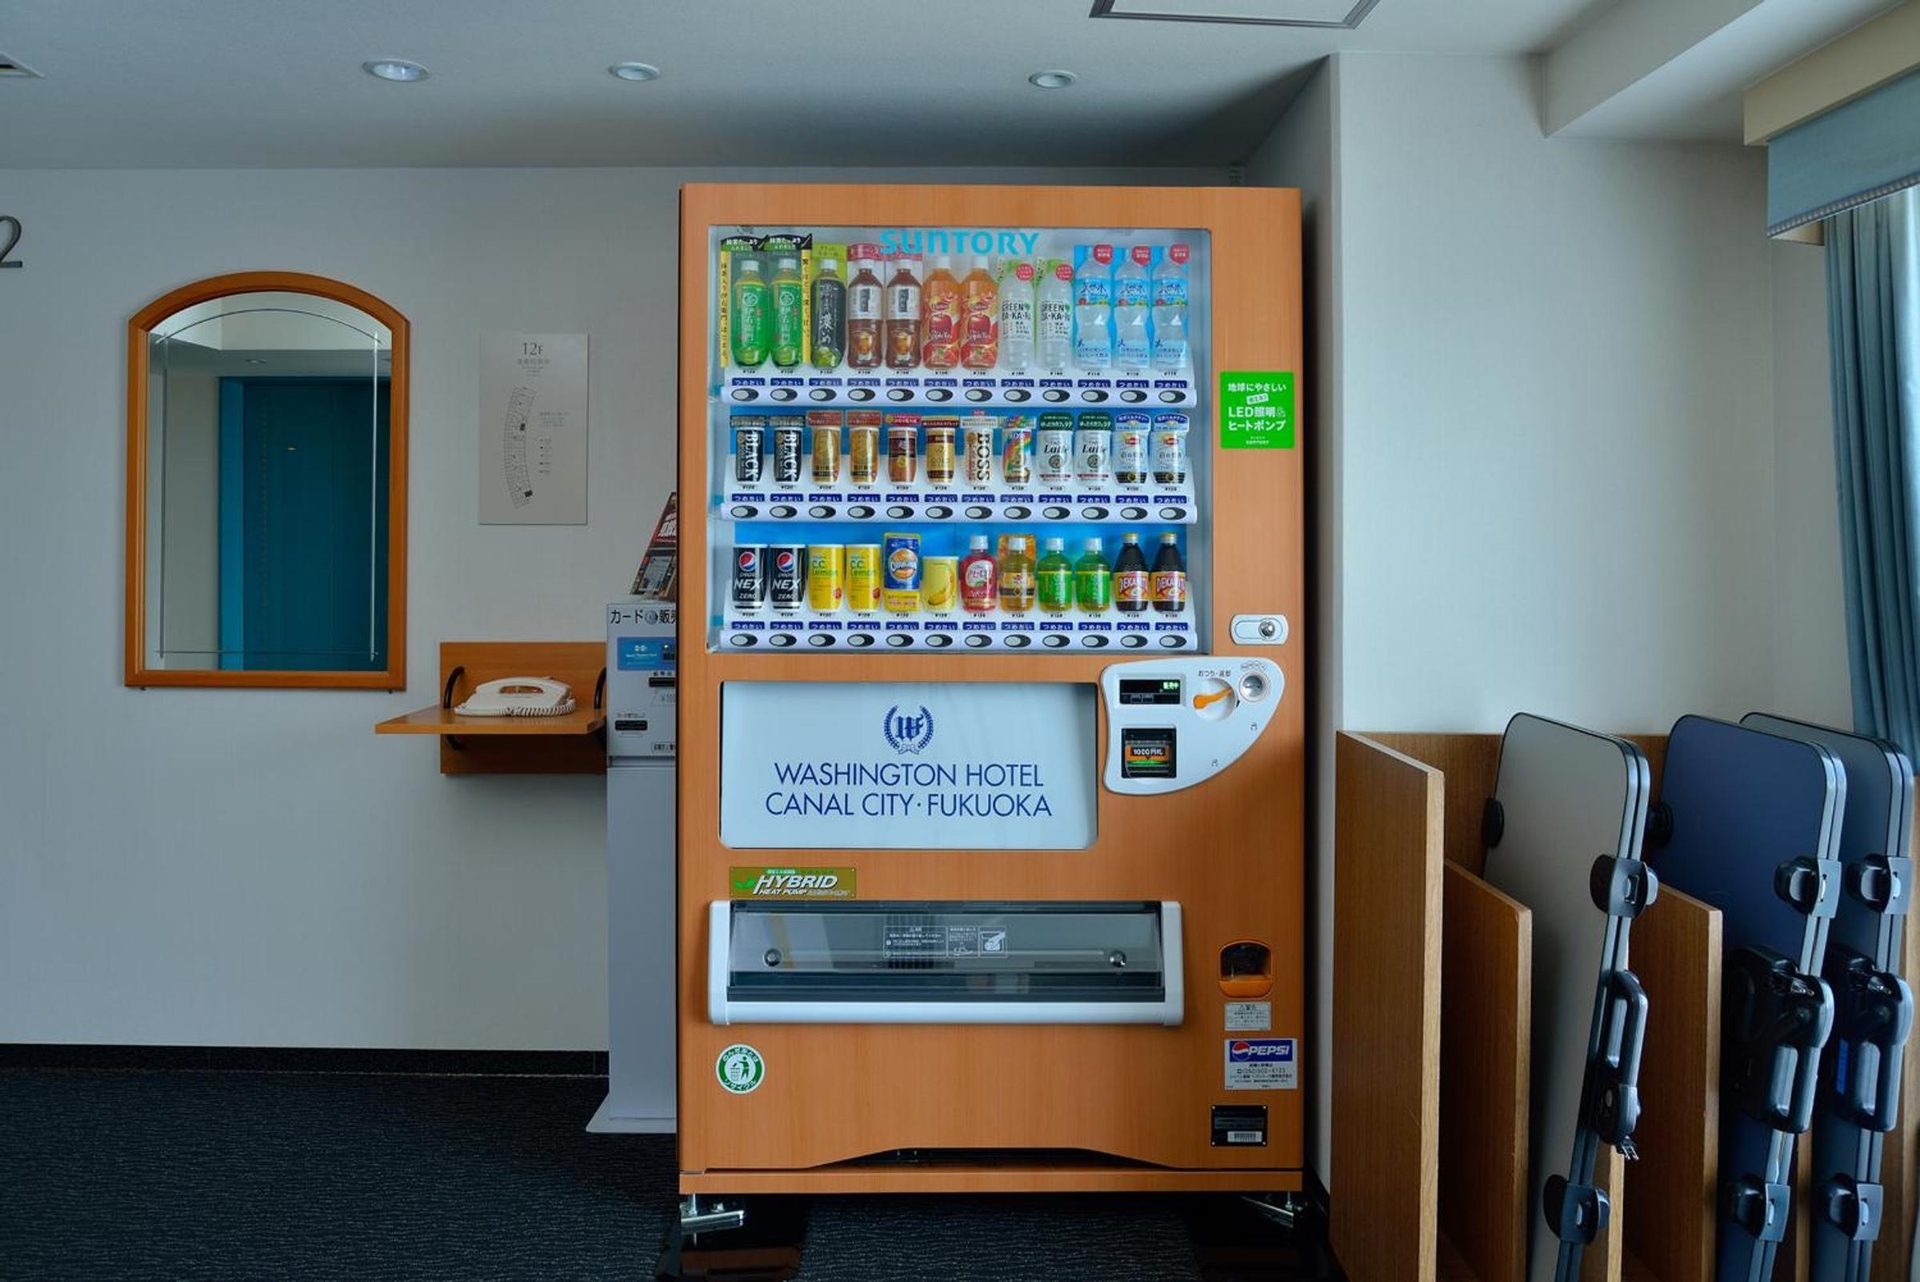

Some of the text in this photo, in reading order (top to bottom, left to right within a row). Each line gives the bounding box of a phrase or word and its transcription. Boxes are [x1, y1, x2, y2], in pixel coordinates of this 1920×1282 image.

[880, 230, 1040, 255] SUNTORY
[1228, 420, 1287, 431] ヒートポンプ
[745, 430, 759, 482] BLACK
[784, 430, 797, 482] BLACK
[977, 433, 990, 482] BOSS
[733, 577, 763, 591] NEX
[771, 577, 801, 591] NEX
[610, 609, 643, 625] カード
[774, 763, 1044, 787] WASHINGTON HOTEL
[765, 792, 854, 816] CANAL
[753, 875, 839, 895] HYBRID
[1248, 1045, 1290, 1056] PEPSI
